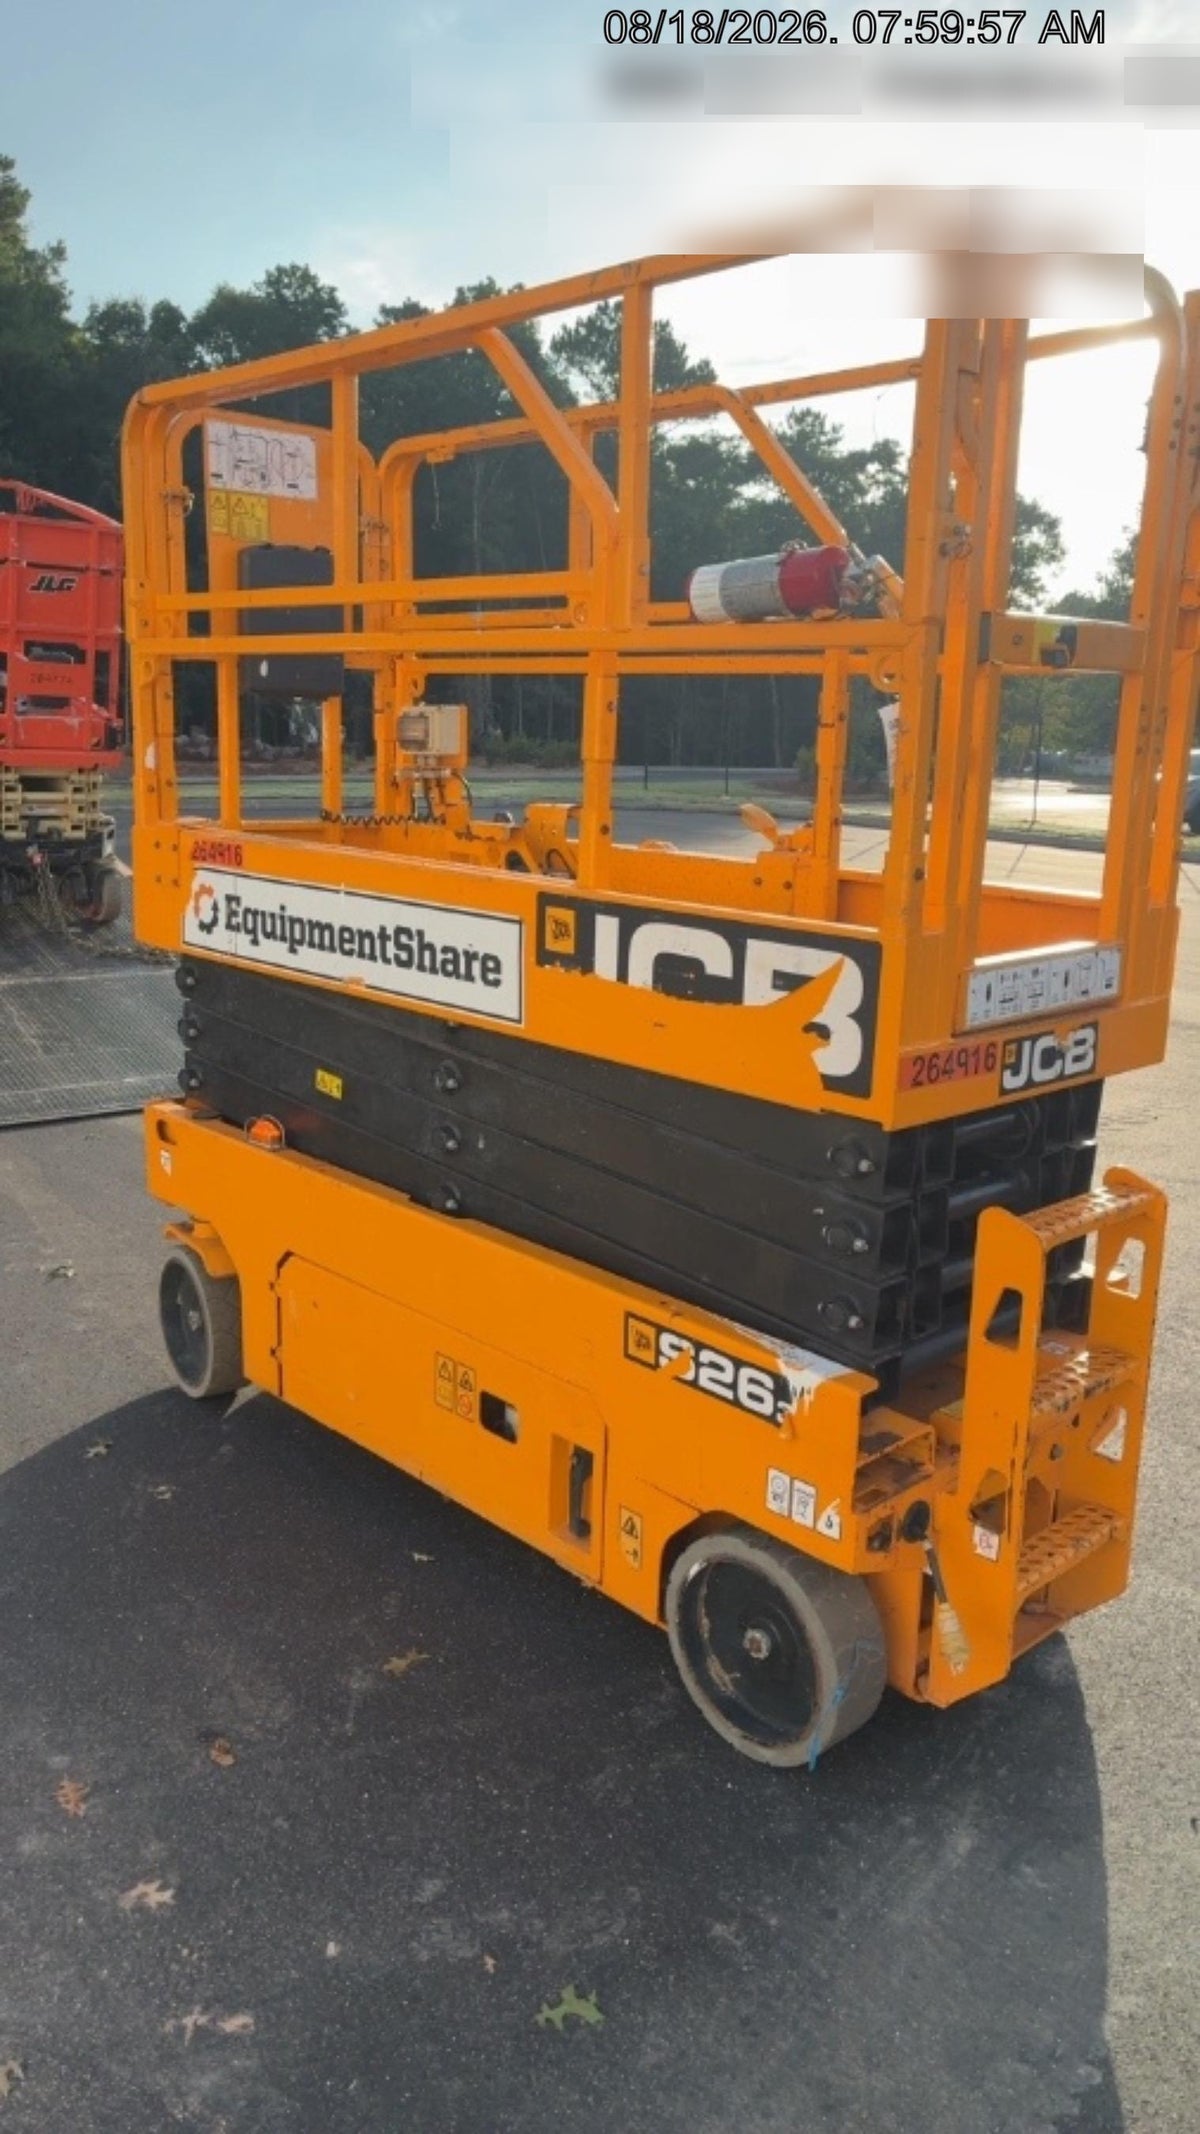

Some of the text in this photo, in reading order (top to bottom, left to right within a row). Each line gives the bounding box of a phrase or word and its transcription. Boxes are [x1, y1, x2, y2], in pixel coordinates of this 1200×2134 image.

[29, 575, 77, 592] JLG
[224, 894, 502, 988] EquipmentShare
[911, 1044, 996, 1086] 264916
[1003, 1027, 1095, 1089] JCB
